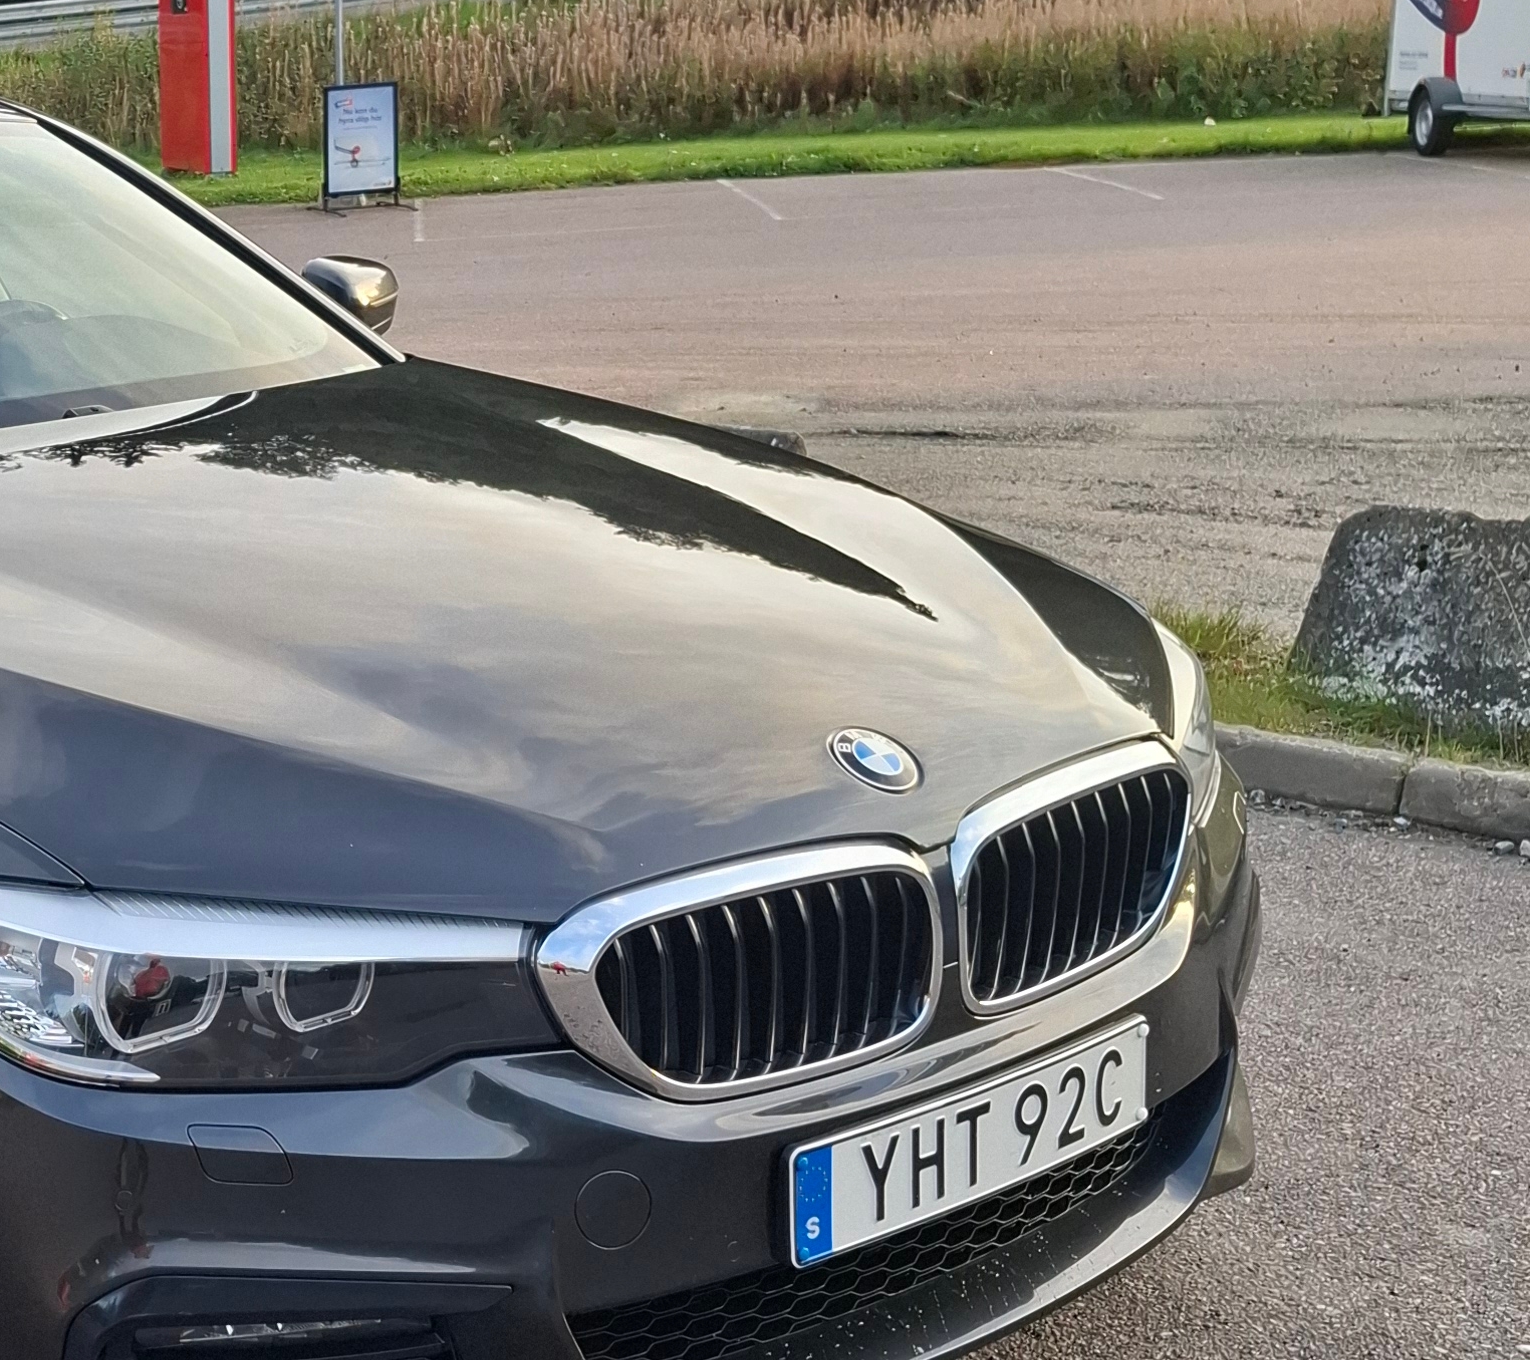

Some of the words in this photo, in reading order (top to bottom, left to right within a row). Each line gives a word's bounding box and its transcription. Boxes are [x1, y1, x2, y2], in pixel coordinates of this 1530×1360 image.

[860, 1103, 991, 1222] YHT
[1015, 1047, 1124, 1165] 92C
[805, 1216, 820, 1239] S
